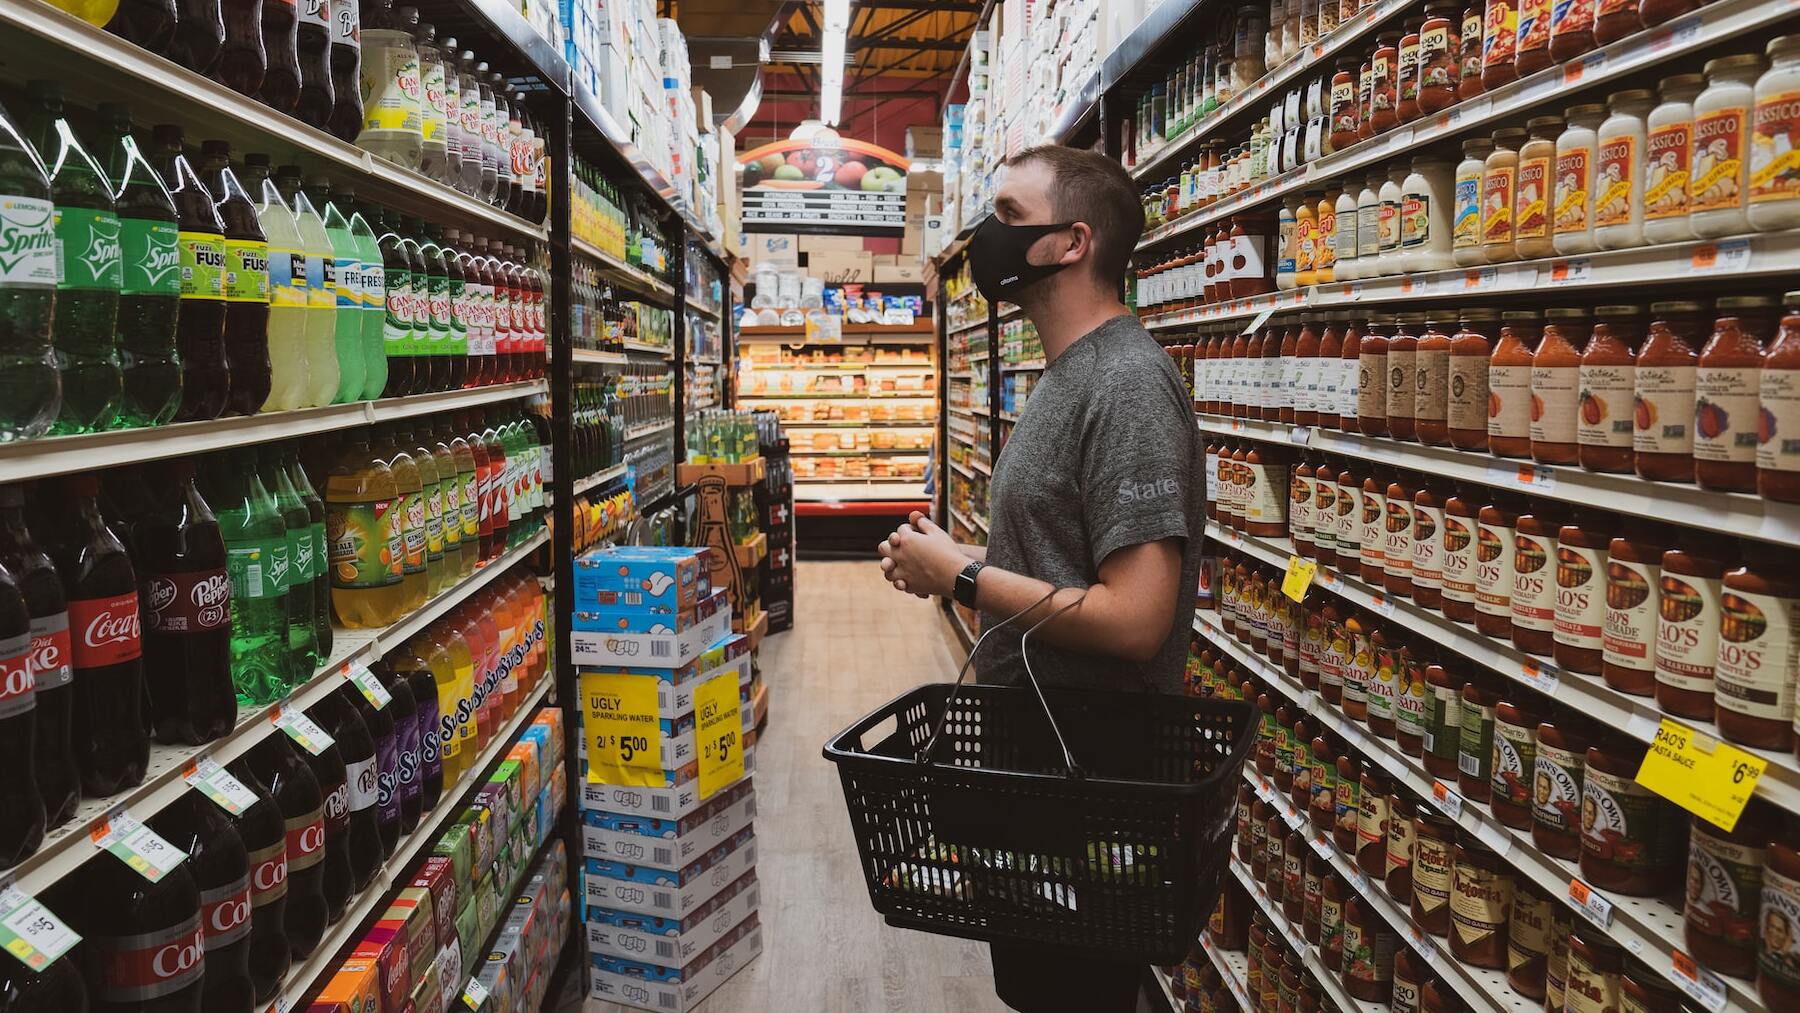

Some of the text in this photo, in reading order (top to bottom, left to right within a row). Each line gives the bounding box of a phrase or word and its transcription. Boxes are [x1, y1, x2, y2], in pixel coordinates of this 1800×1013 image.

[816, 157, 834, 182] 2
[1119, 478, 1178, 504] State
[591, 697, 622, 711] UGLY
[700, 703, 718, 721] UGLY
[591, 712, 655, 724] SPARKLING WATER
[1655, 728, 1686, 750] RAO'S
[1650, 742, 1697, 770] PASTA SAUCE
